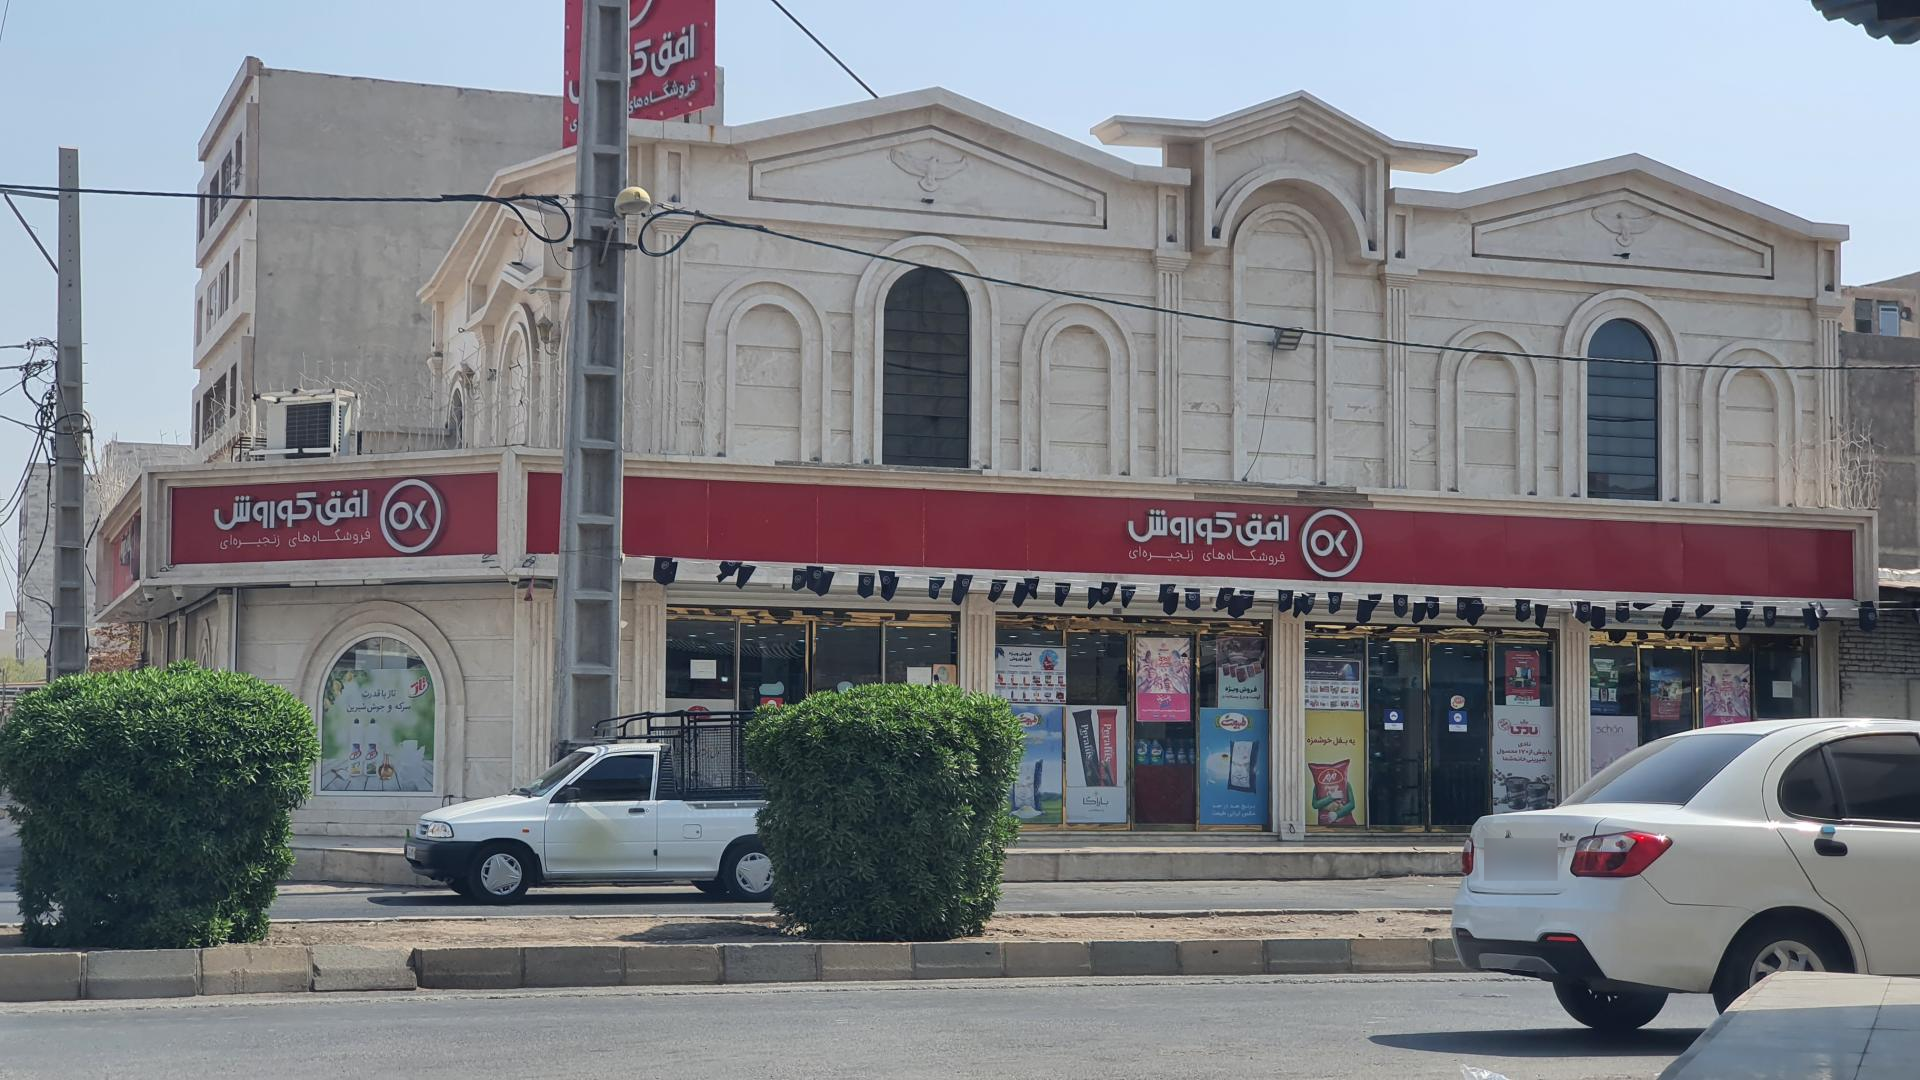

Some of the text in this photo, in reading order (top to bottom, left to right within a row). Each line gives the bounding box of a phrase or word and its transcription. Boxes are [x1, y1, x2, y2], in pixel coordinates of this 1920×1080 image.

[651, 23, 695, 77] افق
[213, 488, 369, 530] افق کوروش
[1127, 508, 1290, 547] افق کوروش
[361, 689, 380, 699] قدرت
[387, 689, 397, 699] ناز
[387, 704, 393, 713] و
[395, 702, 412, 712] سرکه
